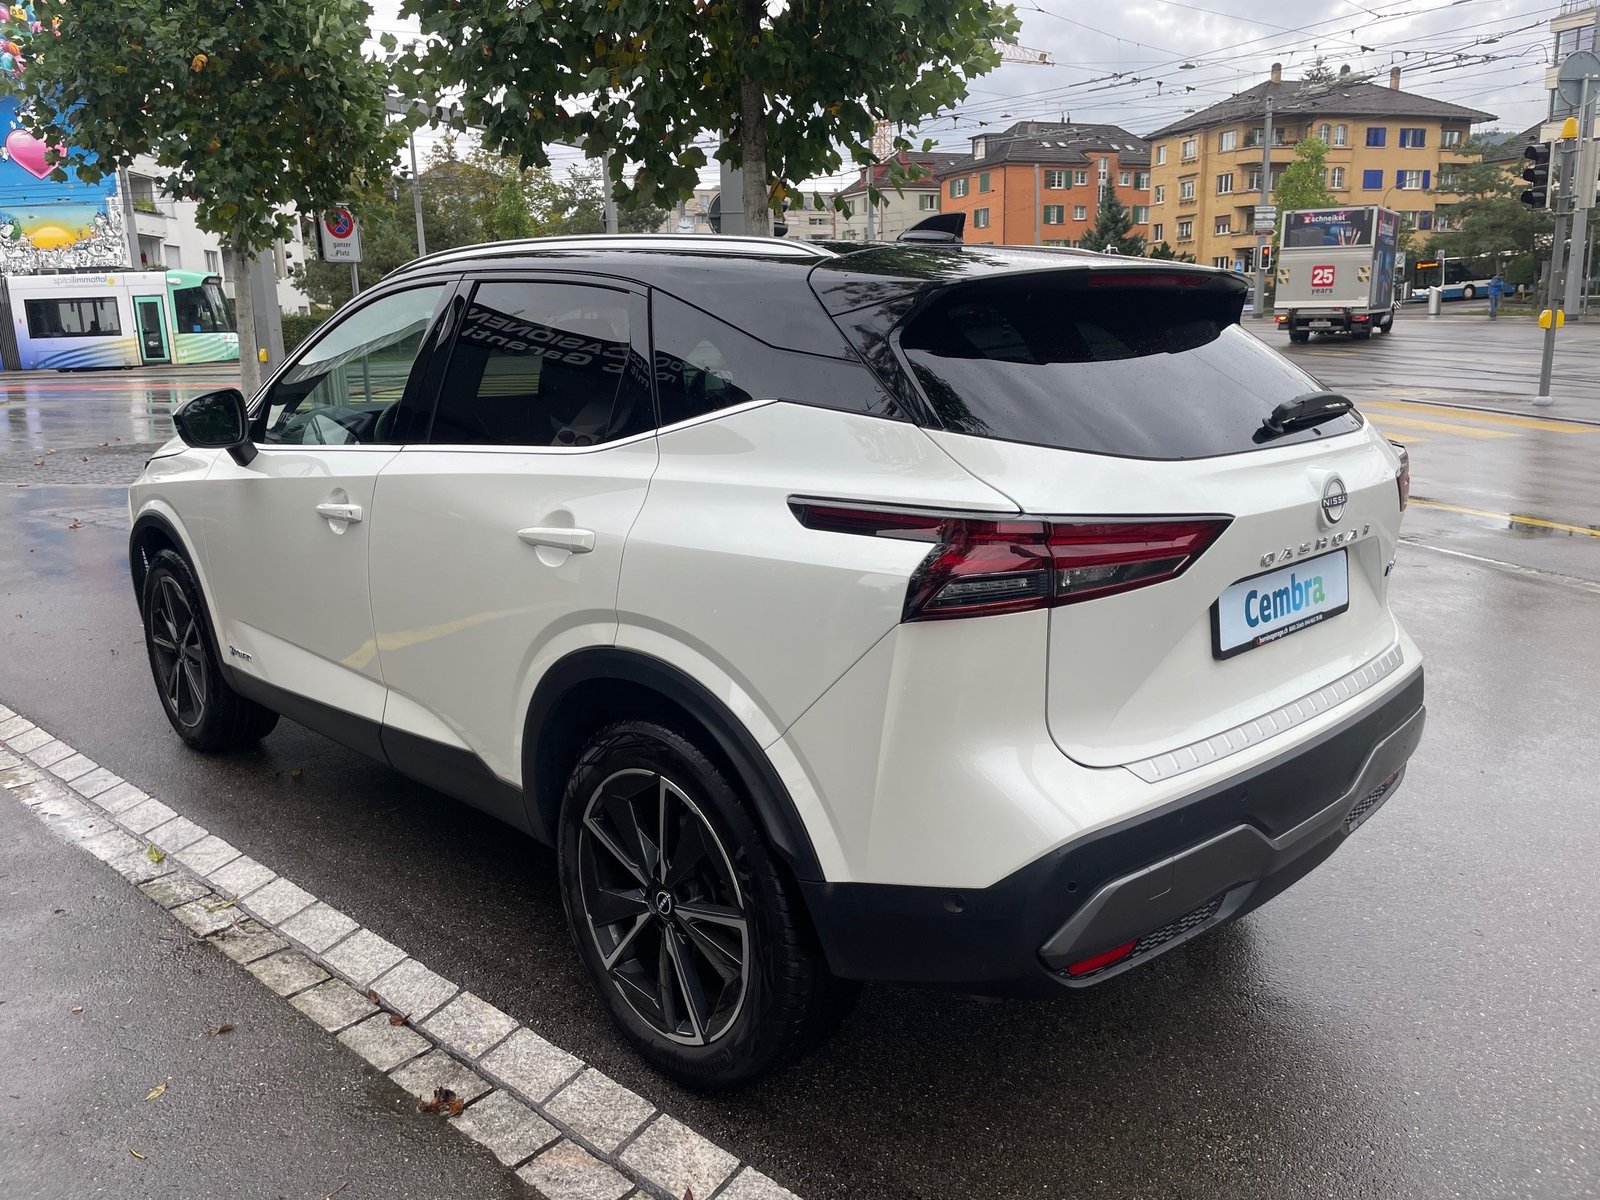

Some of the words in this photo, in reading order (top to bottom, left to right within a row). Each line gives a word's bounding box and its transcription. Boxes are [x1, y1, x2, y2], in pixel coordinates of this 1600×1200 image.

[1312, 268, 1334, 284] 25
[1311, 287, 1334, 296] years
[1245, 573, 1325, 627] Cembra
